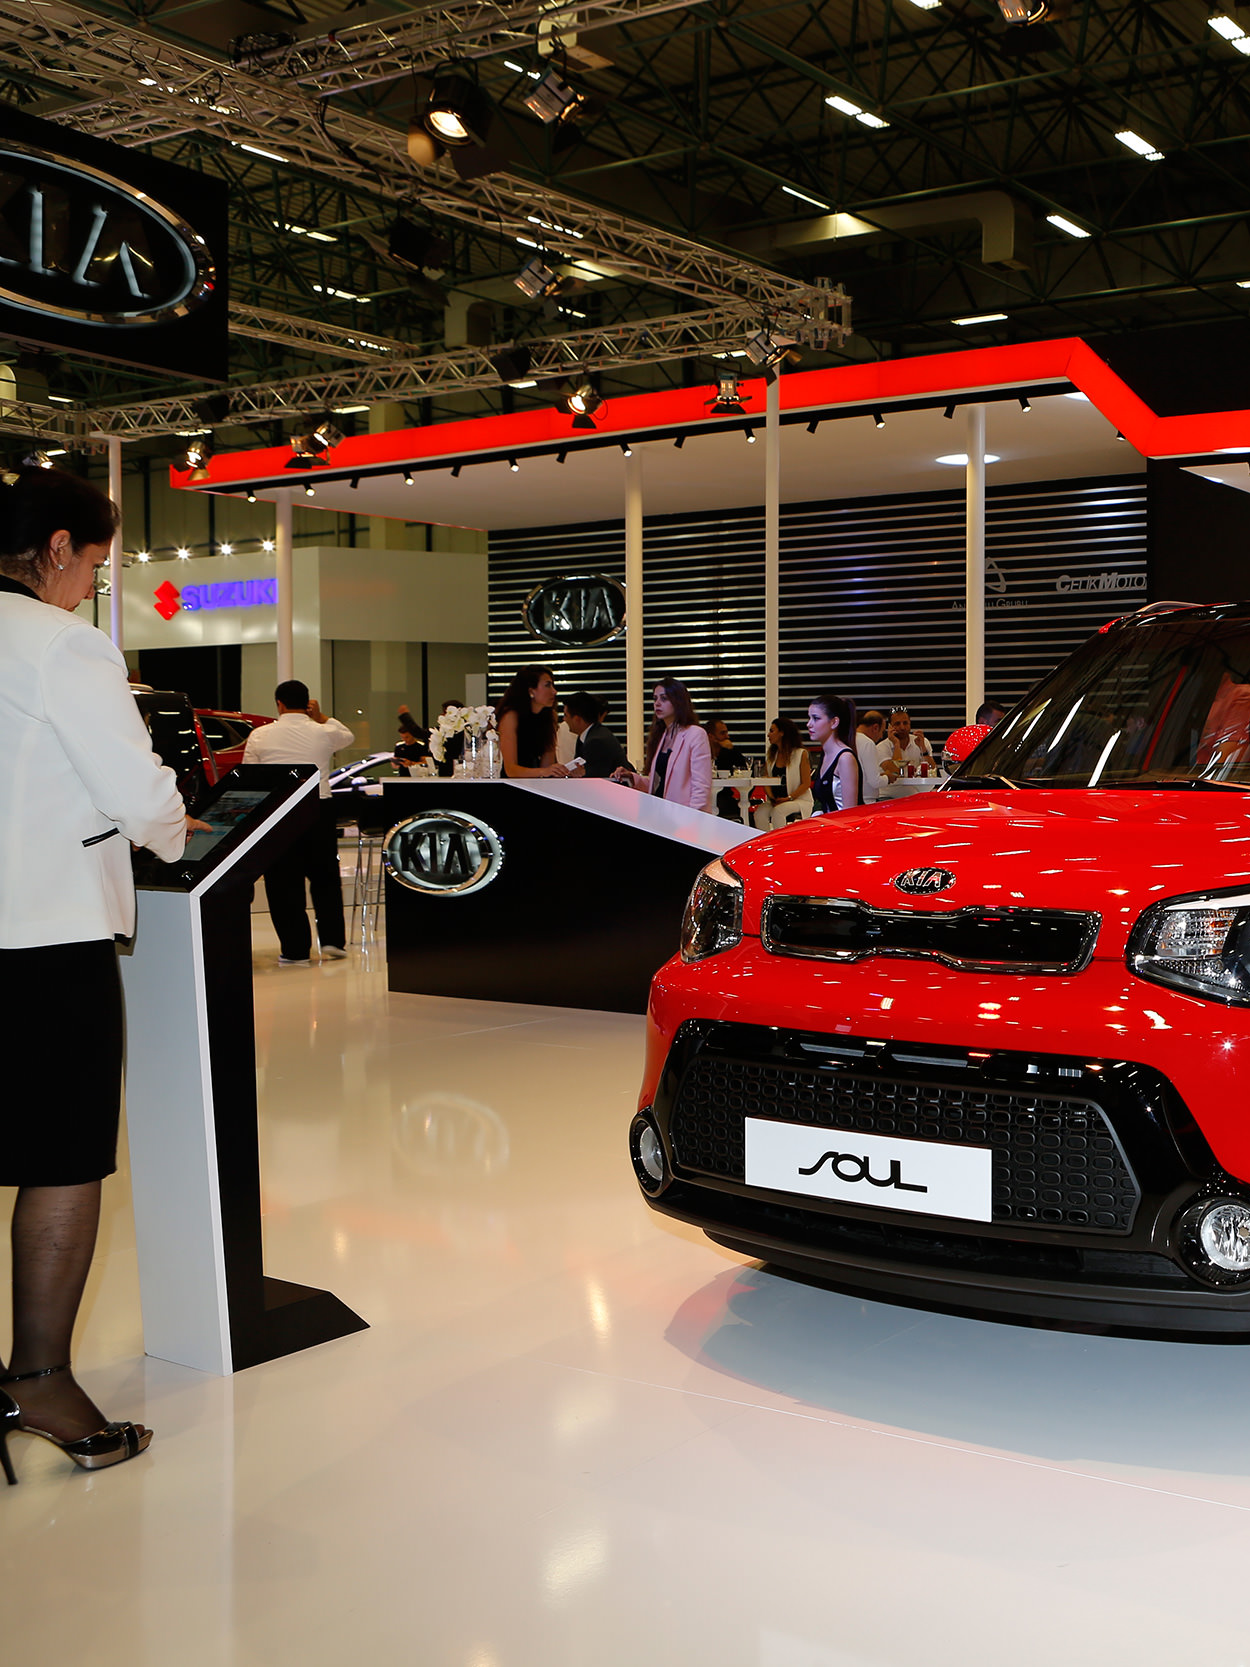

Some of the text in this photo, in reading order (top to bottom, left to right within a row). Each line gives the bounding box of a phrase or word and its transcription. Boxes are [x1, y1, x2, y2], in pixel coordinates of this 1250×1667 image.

[544, 587, 616, 631] KIA
[400, 831, 474, 876] KIA
[901, 869, 943, 888] KIA
[798, 1150, 928, 1194] SOUL
